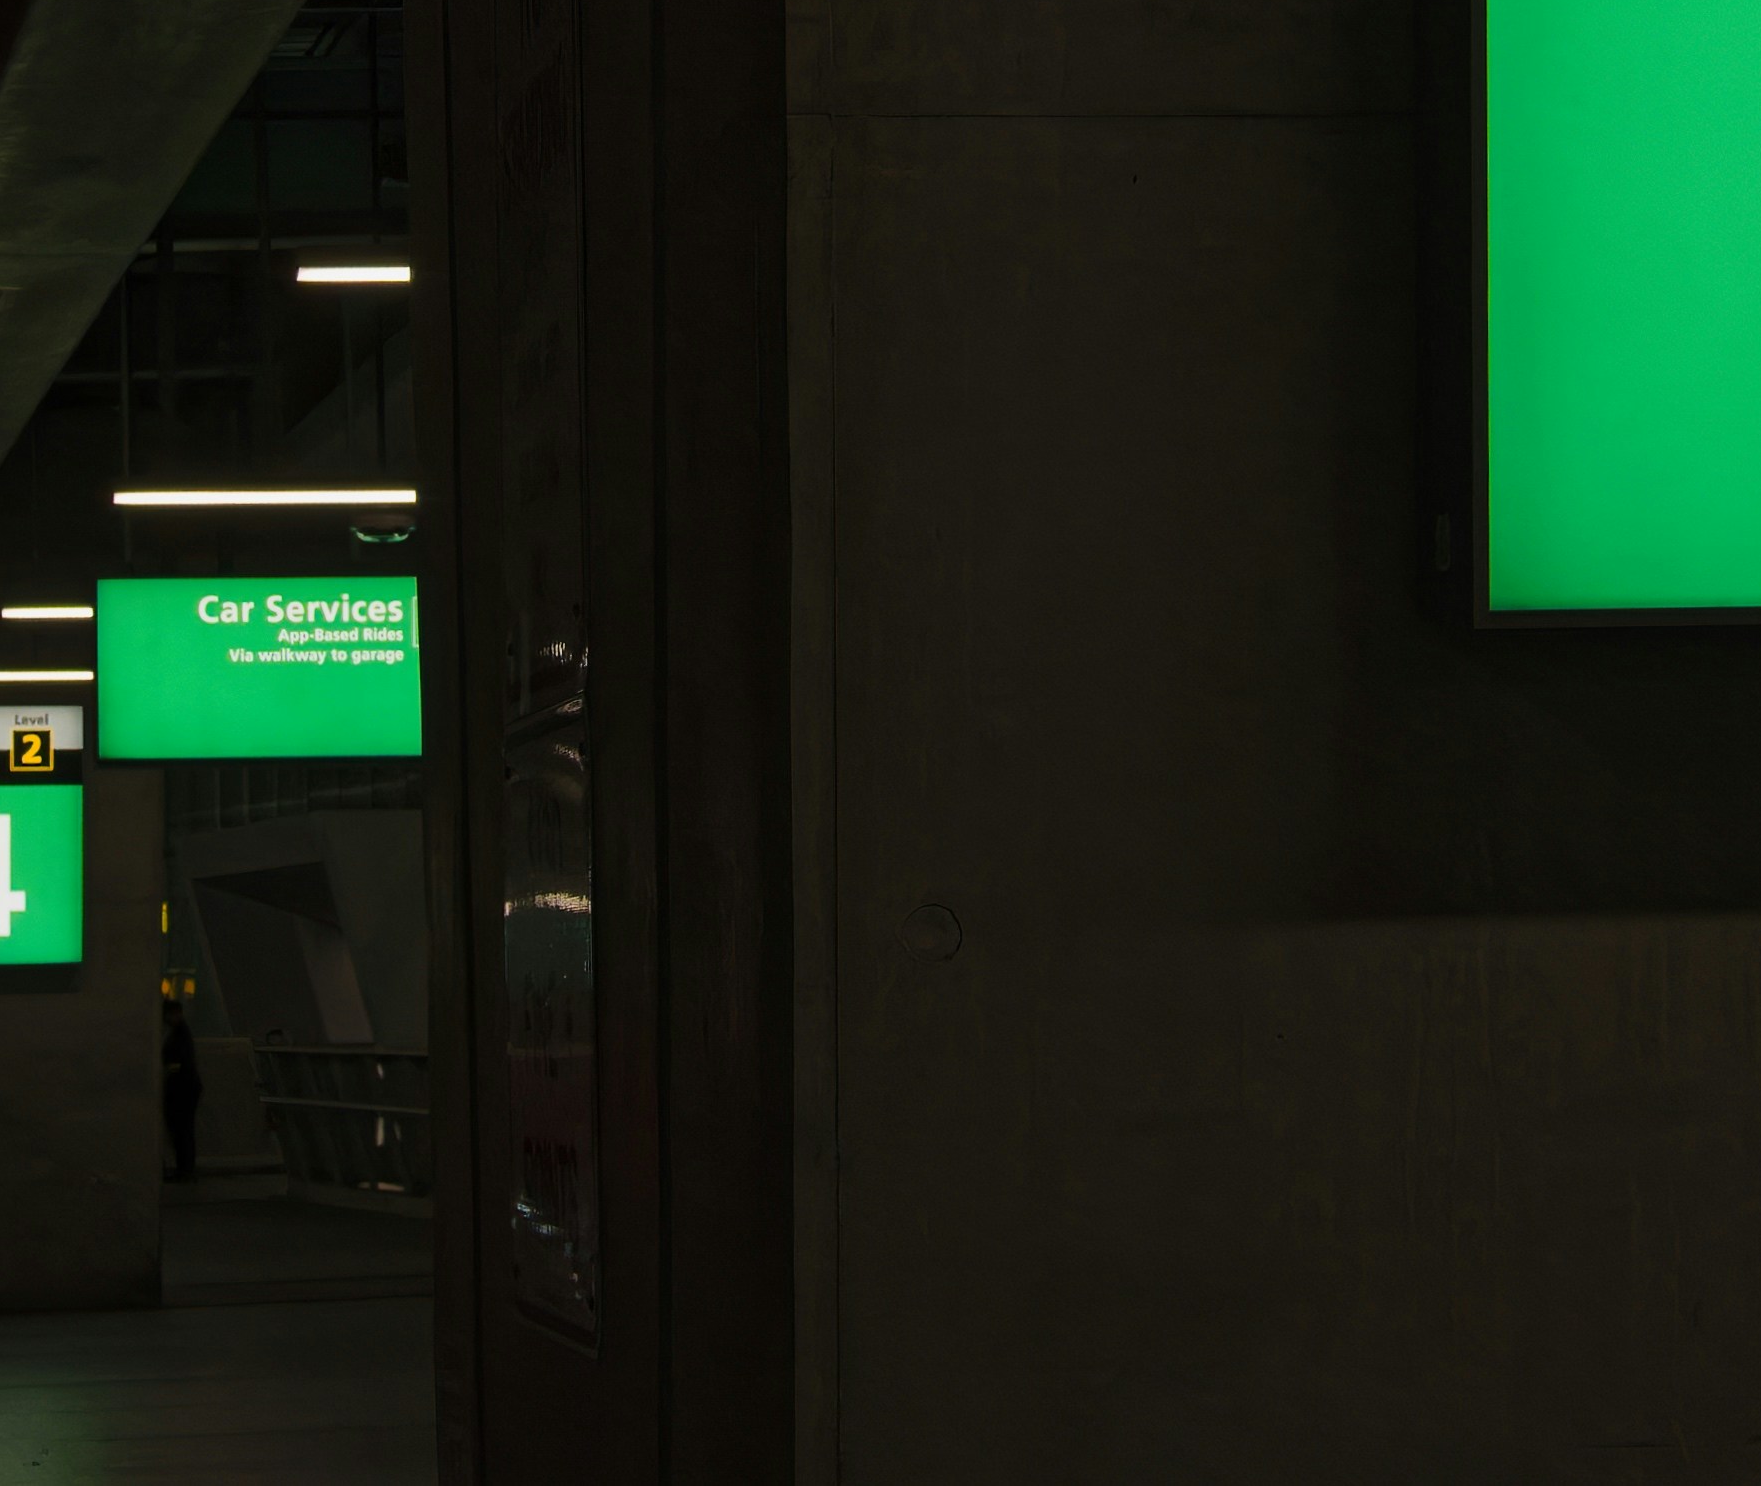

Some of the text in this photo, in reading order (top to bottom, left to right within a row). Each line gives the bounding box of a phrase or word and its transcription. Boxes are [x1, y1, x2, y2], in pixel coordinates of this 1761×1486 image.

[197, 594, 404, 624] Car Services
[277, 627, 404, 645] App-Based Rides
[229, 648, 404, 665] Via walkway to garage
[14, 714, 49, 726] Level
[21, 734, 43, 764] 2
